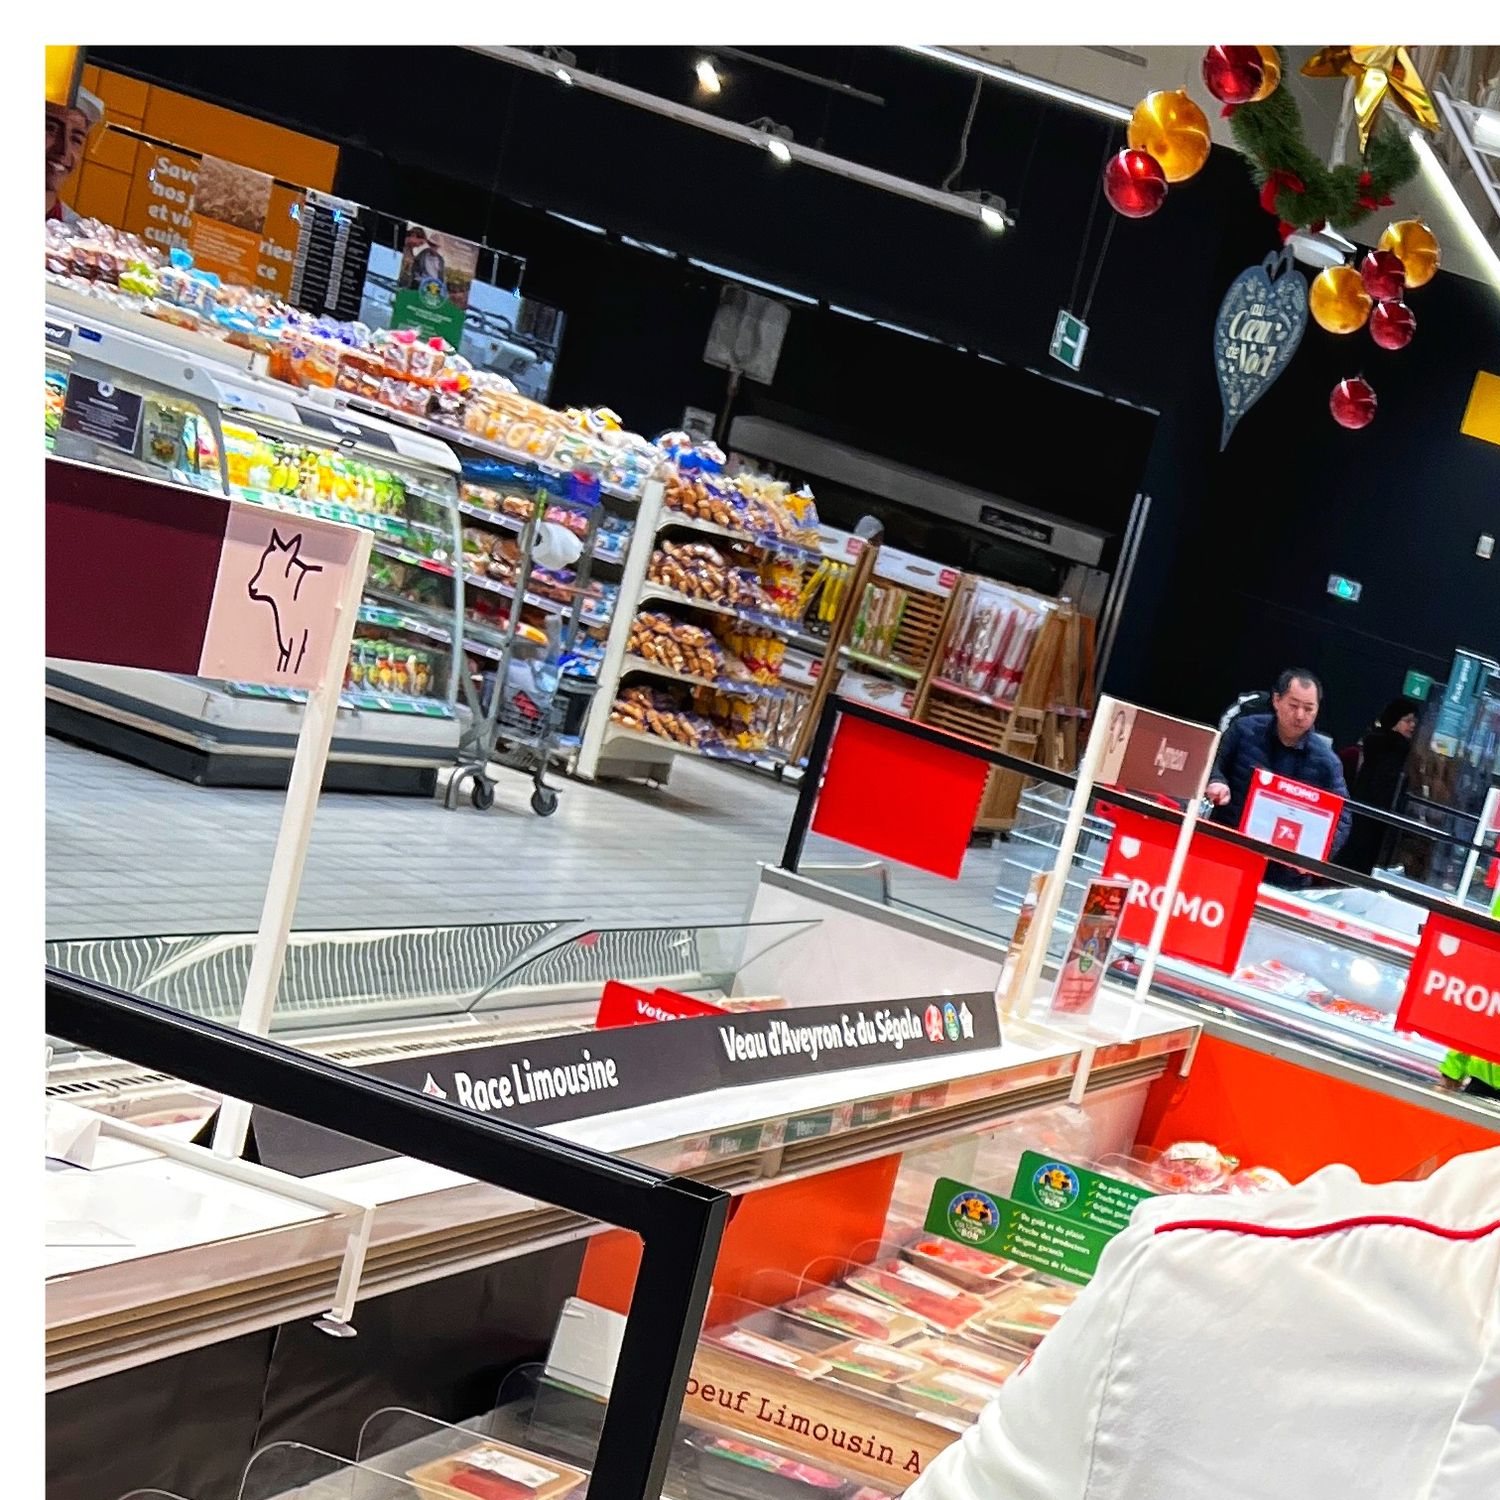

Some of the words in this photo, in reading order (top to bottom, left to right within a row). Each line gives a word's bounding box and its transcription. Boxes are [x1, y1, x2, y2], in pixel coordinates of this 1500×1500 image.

[1277, 780, 1320, 803] PROMO
[1112, 872, 1225, 928] ROMO
[454, 1071, 515, 1112] Race
[511, 1048, 620, 1105] Limousine
[720, 1025, 769, 1062] Veau
[769, 1018, 843, 1062] d'Aveyron
[840, 1013, 858, 1048] &
[856, 1012, 877, 1046] du
[875, 1007, 924, 1050] Ségala
[756, 1397, 894, 1466] Limousin
[902, 1450, 921, 1475] A
